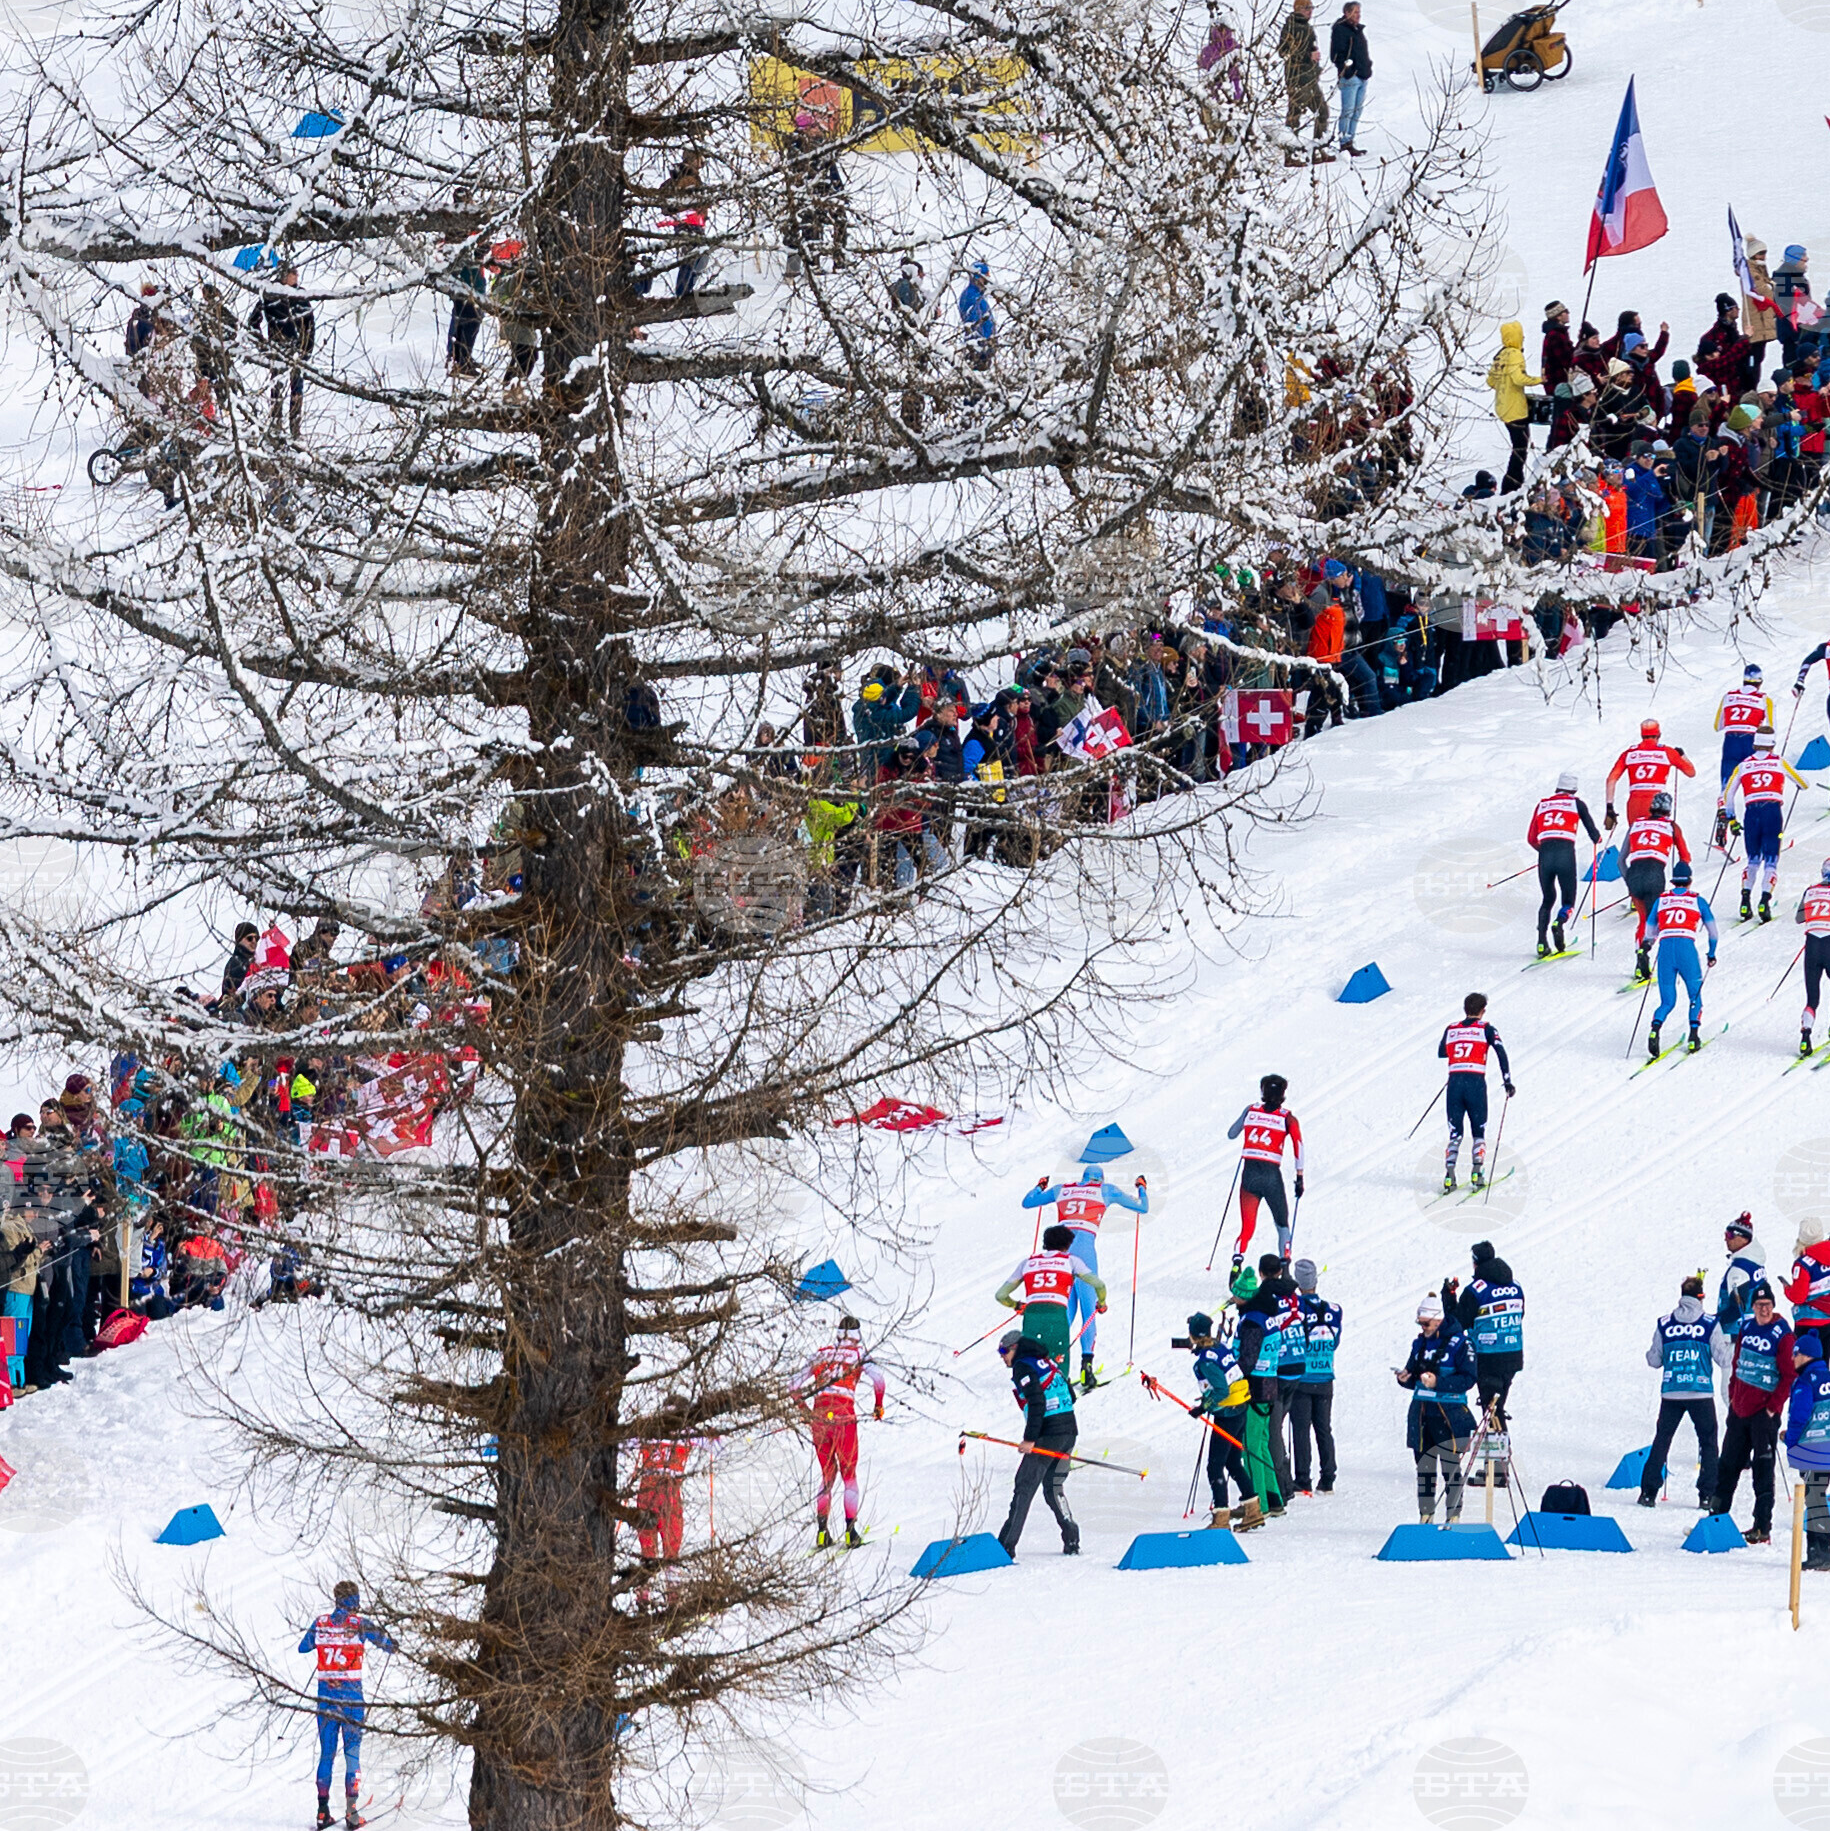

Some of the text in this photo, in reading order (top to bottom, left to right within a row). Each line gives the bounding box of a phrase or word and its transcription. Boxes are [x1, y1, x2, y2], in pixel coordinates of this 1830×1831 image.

[1730, 706, 1752, 721] 27
[1635, 764, 1658, 780] 67
[1751, 772, 1773, 788] 39
[1543, 812, 1566, 827] 54
[1637, 832, 1661, 846] 45
[1811, 901, 1830, 917] 72
[1665, 909, 1687, 925] 70
[1453, 1042, 1474, 1059] 57
[1248, 1127, 1272, 1146] 44
[1064, 1200, 1087, 1215] 51
[1032, 1272, 1058, 1289] 53
[1491, 1286, 1519, 1298] coop
[1665, 1324, 1705, 1338] coop
[1310, 1361, 1330, 1370] USA
